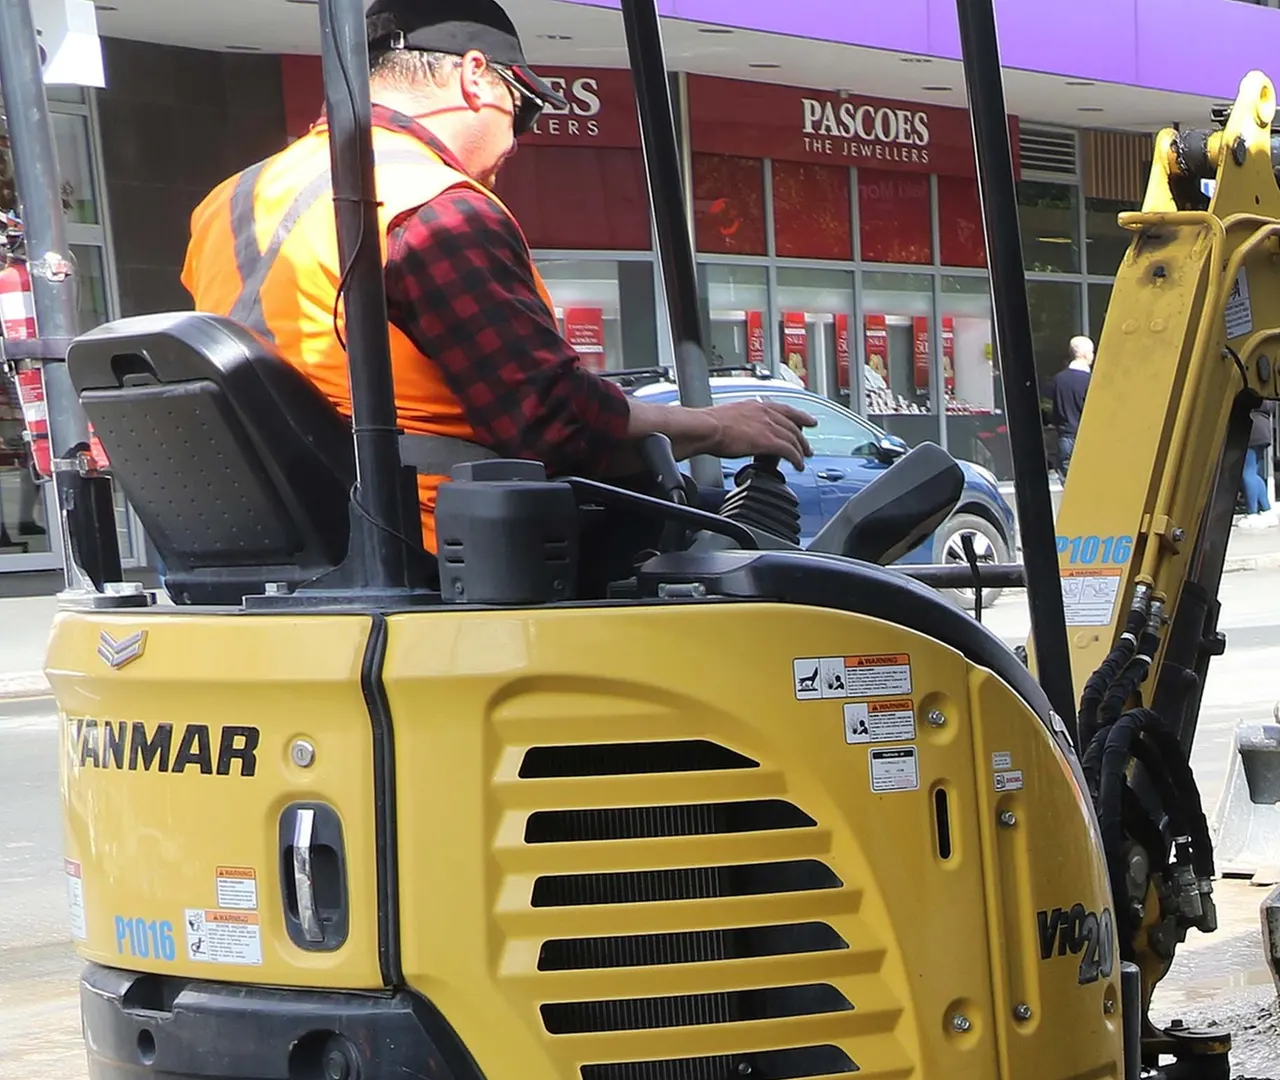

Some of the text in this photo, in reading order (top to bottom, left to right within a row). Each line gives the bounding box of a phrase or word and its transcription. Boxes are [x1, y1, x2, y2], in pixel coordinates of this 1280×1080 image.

[801, 98, 930, 146] PASCOES
[803, 137, 930, 164] THE JEWELLERS
[1055, 535, 1133, 565] P1016
[864, 656, 899, 665] WARNING
[878, 702, 910, 711] WARNING
[67, 718, 261, 778] YANMAR
[224, 869, 253, 878] WARNING
[114, 914, 177, 962] P1016
